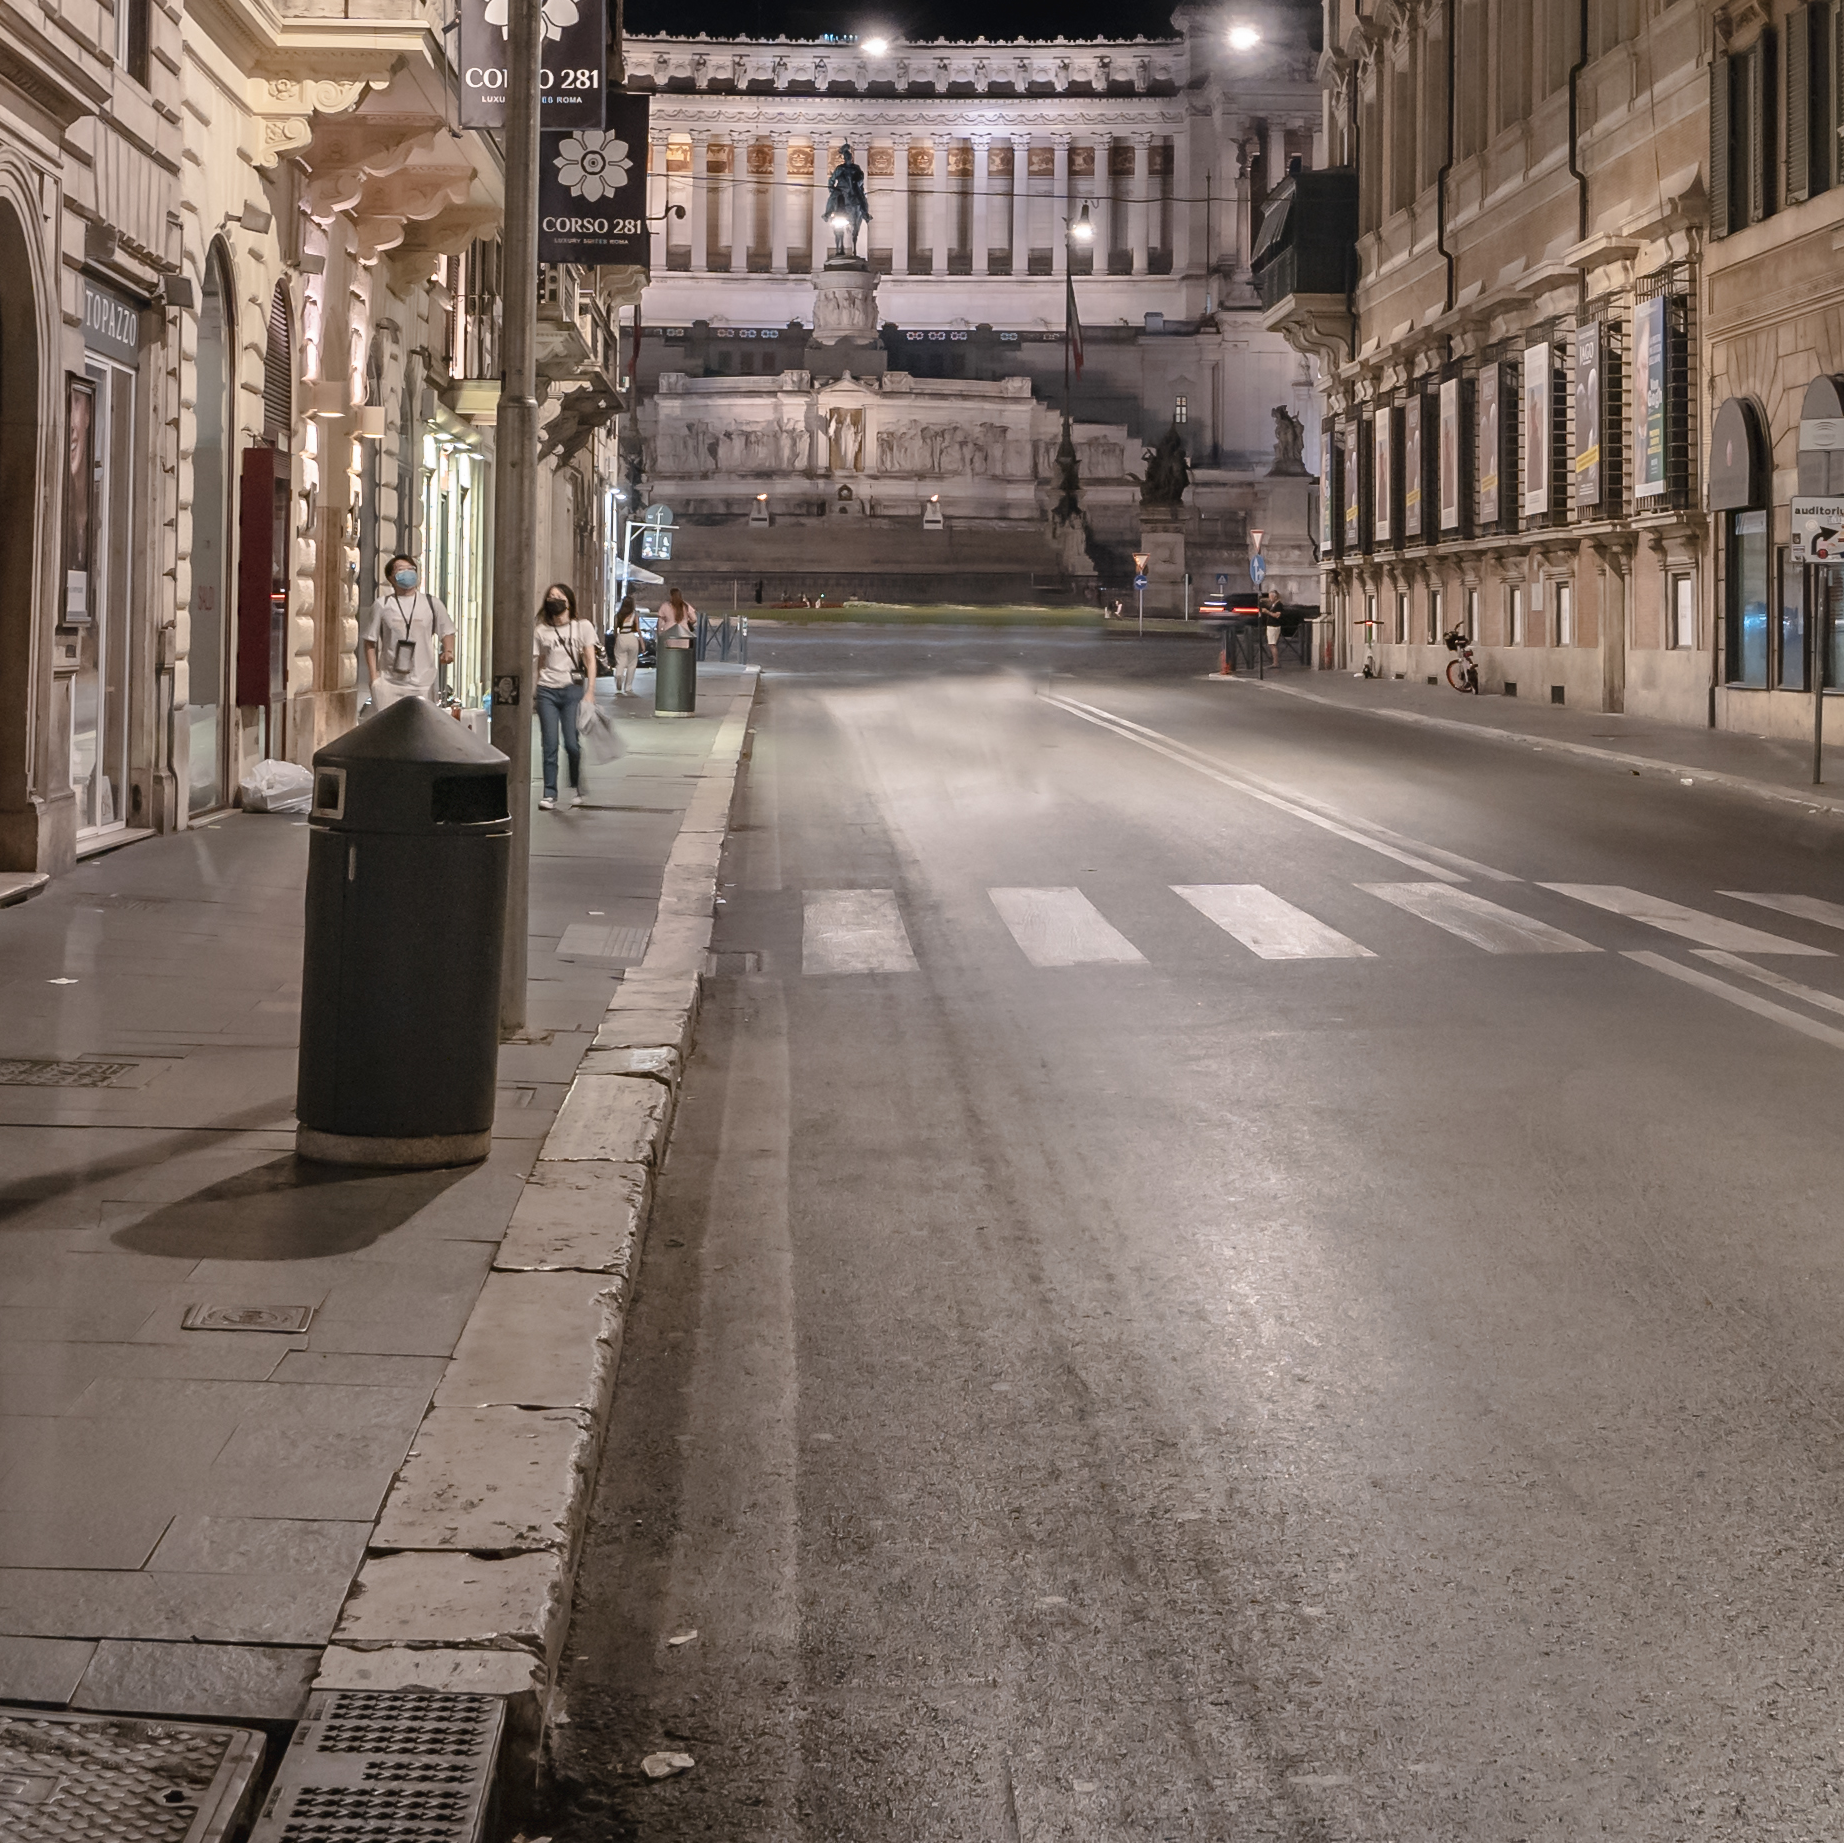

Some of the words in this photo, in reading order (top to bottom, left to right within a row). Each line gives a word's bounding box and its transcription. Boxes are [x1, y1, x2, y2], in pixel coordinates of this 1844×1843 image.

[466, 67, 554, 89] COO
[561, 69, 599, 89] 281
[481, 95, 505, 103] LUXU
[557, 96, 583, 104] ROMA
[542, 217, 609, 233] CORSO
[613, 219, 642, 234] 281
[85, 289, 137, 347] TOPAZZO
